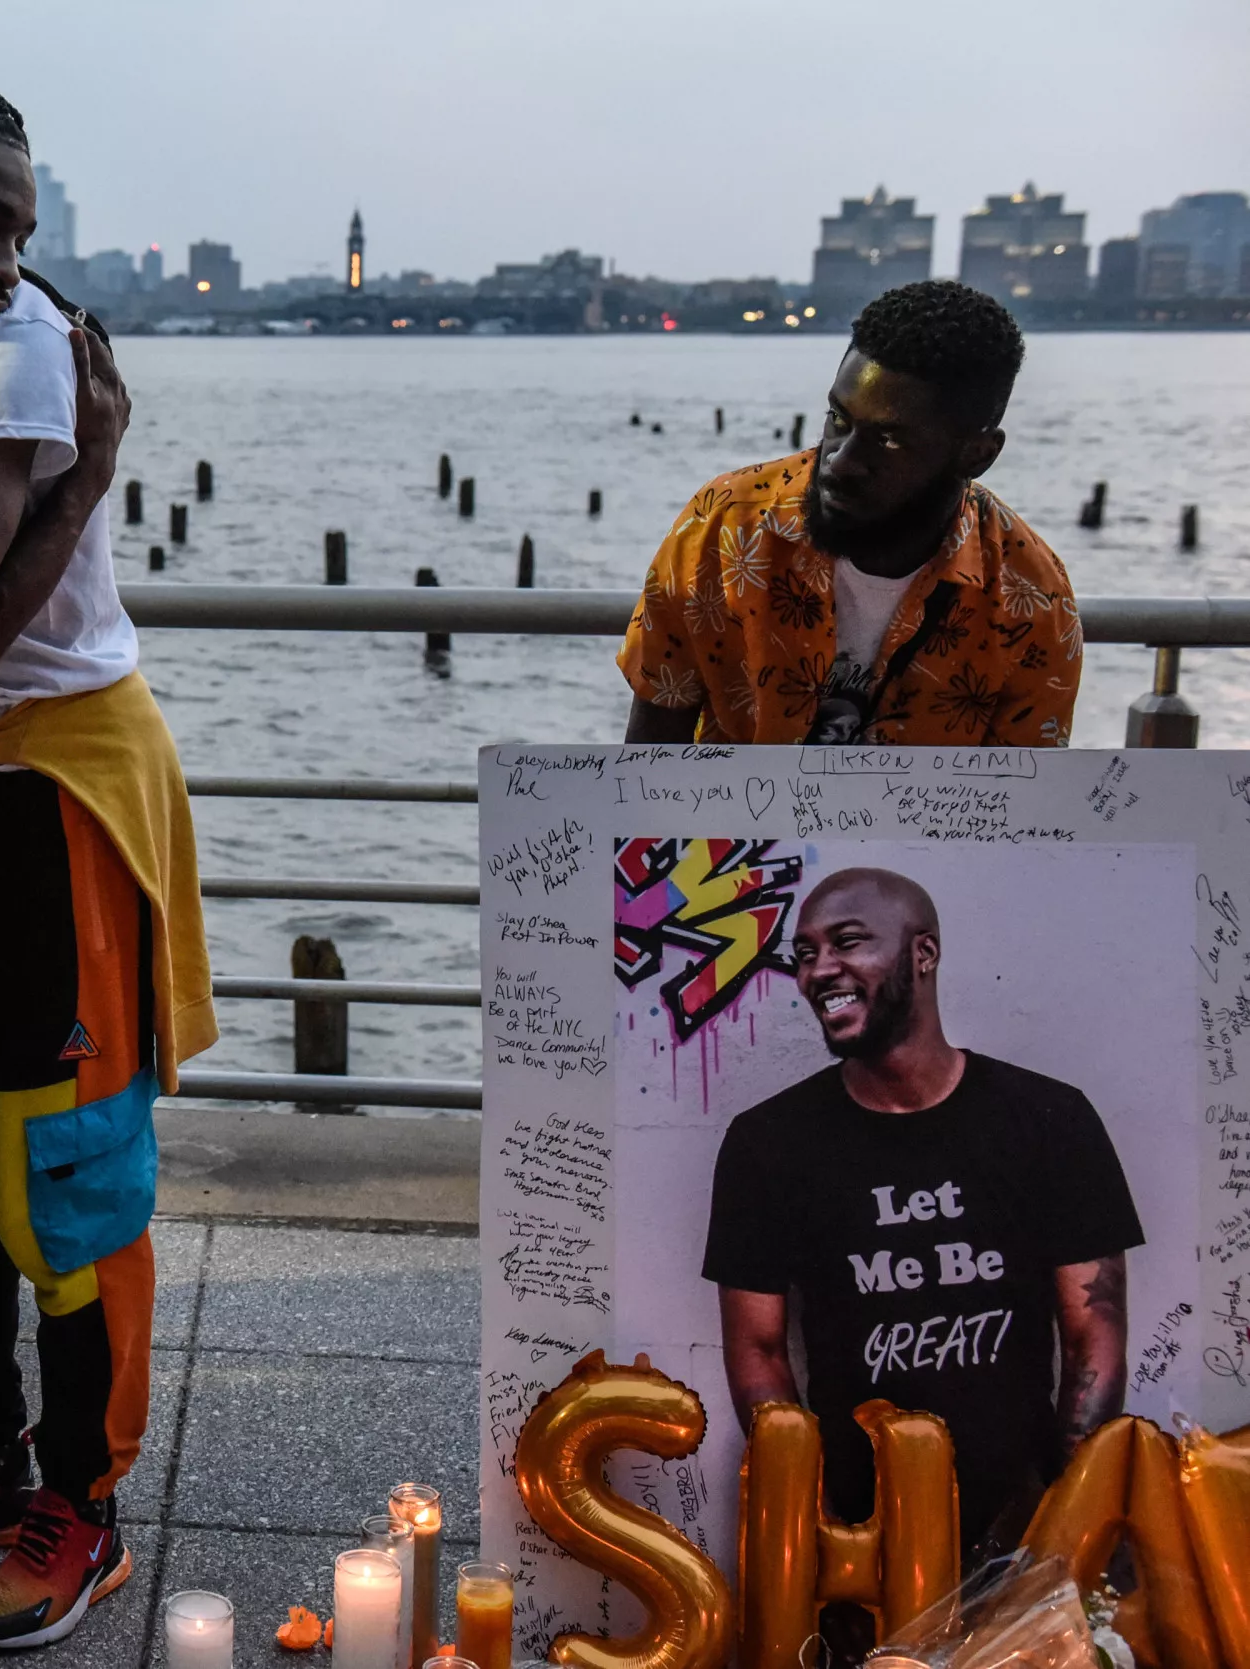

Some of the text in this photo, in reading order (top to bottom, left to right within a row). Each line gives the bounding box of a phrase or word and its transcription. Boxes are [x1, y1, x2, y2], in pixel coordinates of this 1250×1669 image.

[615, 748, 648, 765] Love
[614, 776, 734, 813] I love you
[788, 777, 823, 803] You
[882, 778, 929, 800] You
[501, 925, 537, 942] Rest
[558, 931, 599, 949] Power
[516, 970, 537, 983] will
[495, 983, 562, 1005] ALWAYS
[488, 1001, 558, 1020] Be a part
[524, 1016, 549, 1036] the
[552, 1019, 584, 1038] NYC
[494, 1034, 538, 1054] Dance
[522, 1052, 548, 1070] love
[871, 1180, 964, 1226] Let
[847, 1242, 1004, 1295] Me Be
[863, 1308, 1013, 1384] GREAT!
